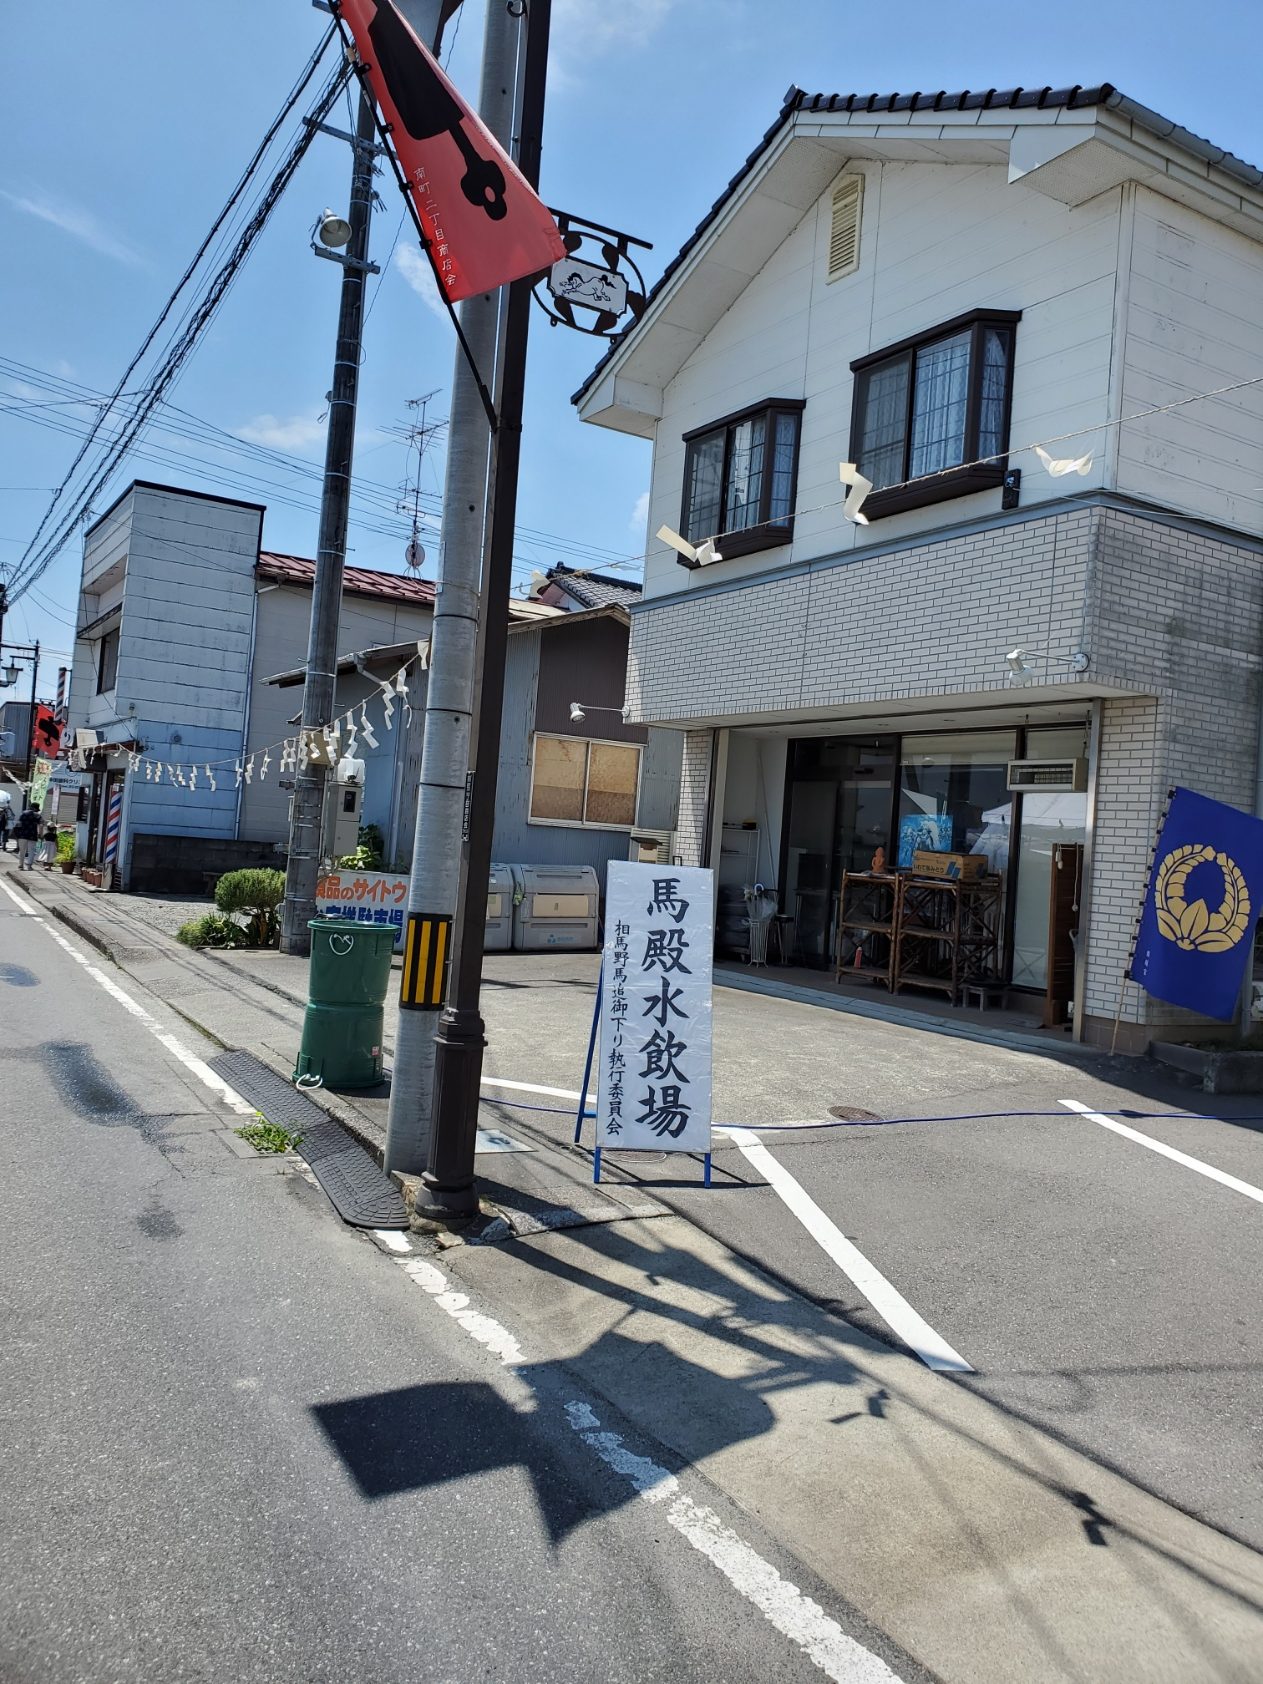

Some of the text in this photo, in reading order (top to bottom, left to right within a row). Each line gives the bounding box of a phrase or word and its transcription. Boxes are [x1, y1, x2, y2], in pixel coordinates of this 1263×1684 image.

[413, 167, 457, 286] 南町二丁目商店会
[605, 919, 631, 1136] 相馬野馬追御下り執行委員会
[634, 877, 694, 1139] 馬殿水飲場
